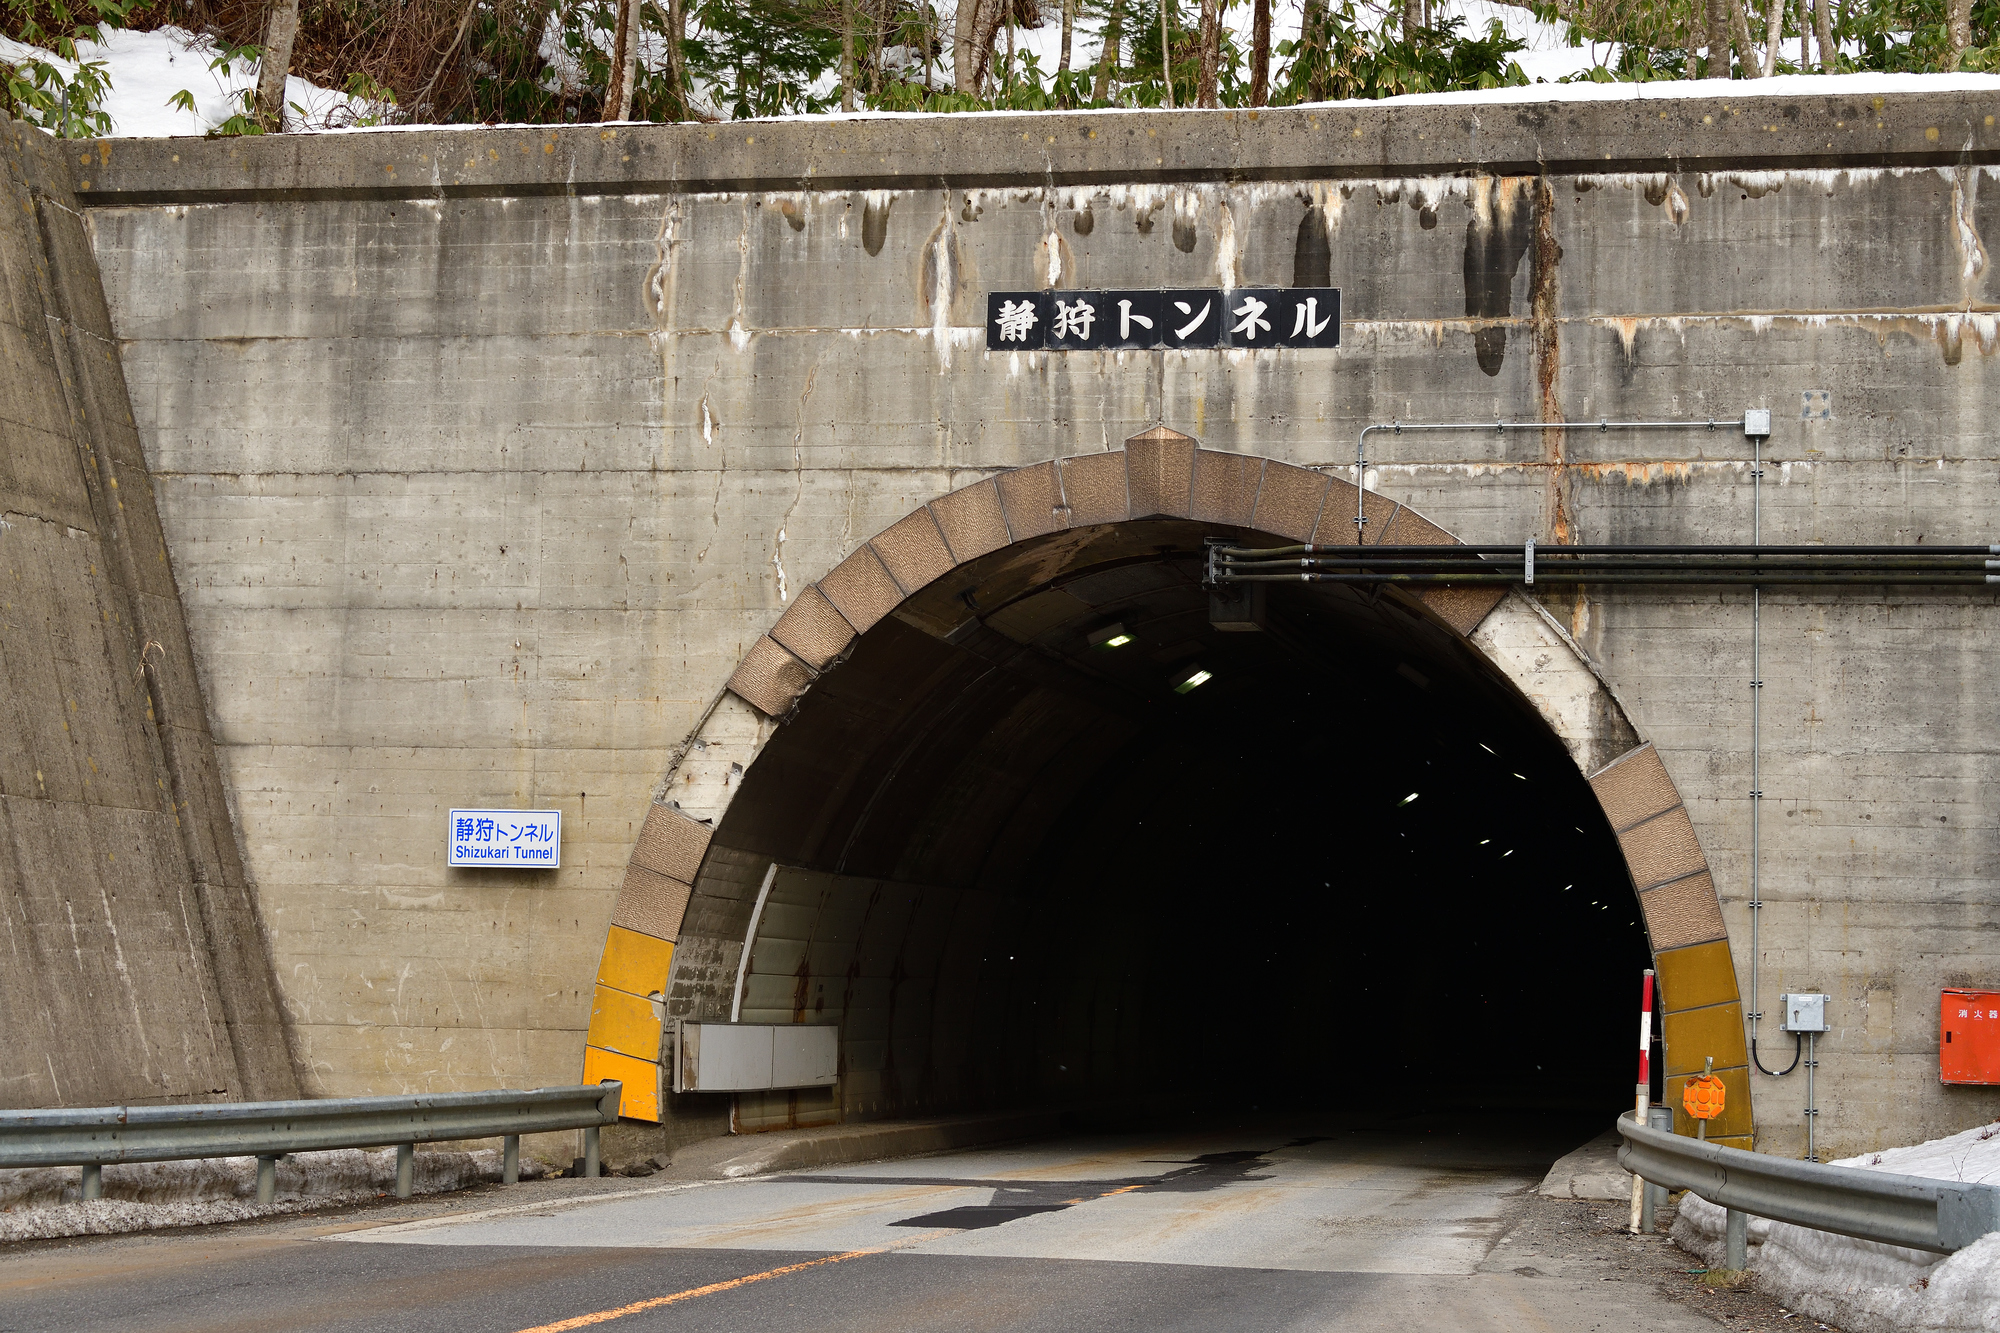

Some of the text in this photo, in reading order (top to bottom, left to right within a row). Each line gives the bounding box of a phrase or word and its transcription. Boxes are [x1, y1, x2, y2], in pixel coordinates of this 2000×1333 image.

[994, 297, 1332, 342] 静狩トンネル
[456, 818, 553, 842] 静狩トンネル
[456, 845, 553, 860] Shizukari Tunnel
[1958, 1009, 1998, 1019] 消火器
